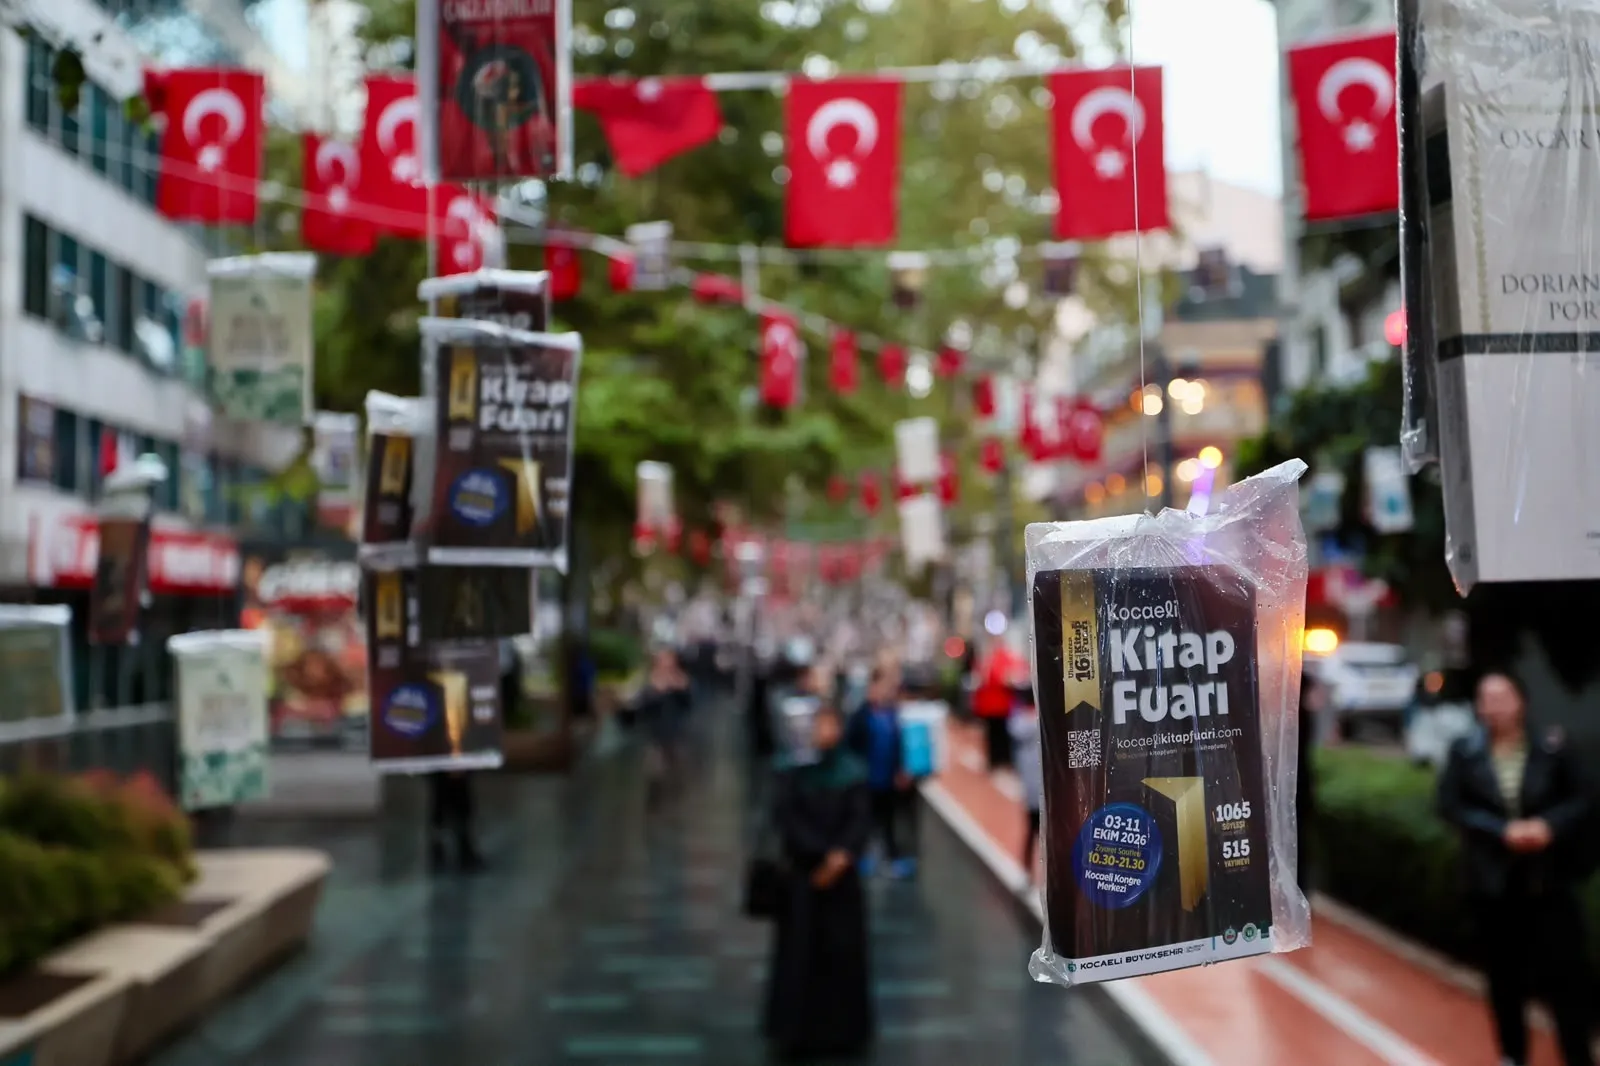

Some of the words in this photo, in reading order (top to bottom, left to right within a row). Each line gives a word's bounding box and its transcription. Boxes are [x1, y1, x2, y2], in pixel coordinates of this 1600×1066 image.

[1500, 128, 1592, 149] OSCAR
[1501, 273, 1600, 294] DORIAN
[1548, 301, 1600, 321] POR
[1106, 600, 1178, 620] Kocaeli
[1110, 625, 1235, 675] Kitap
[1112, 680, 1229, 725] Fuarı
[1116, 727, 1243, 749] kocaelikitapfuari.com
[1216, 801, 1252, 823] 1065
[1104, 814, 1140, 832] 03-11
[1120, 832, 1147, 846] 2026
[1222, 838, 1251, 859] 515
[1088, 850, 1145, 870] 10.30-21.30
[1085, 869, 1113, 882] Kocaeli
[1114, 873, 1142, 886] Kongre
[1097, 881, 1127, 893] Merkezi
